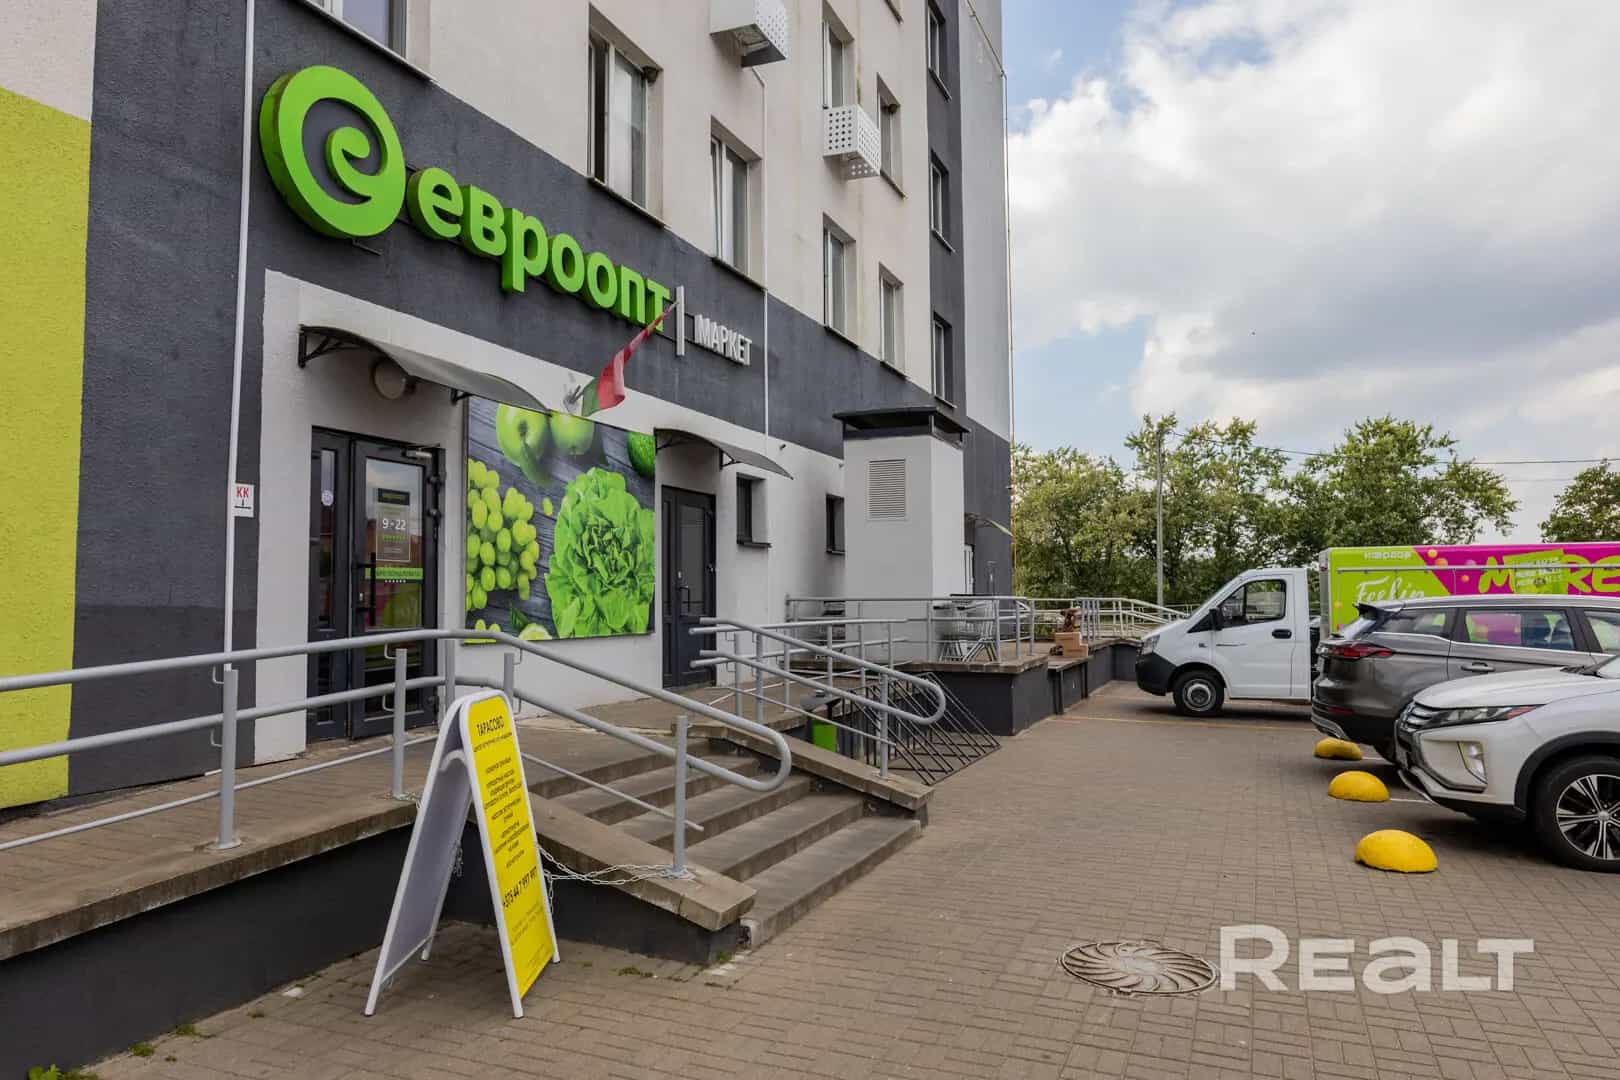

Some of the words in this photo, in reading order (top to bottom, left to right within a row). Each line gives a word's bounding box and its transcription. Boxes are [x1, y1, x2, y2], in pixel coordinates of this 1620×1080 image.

[407, 168, 671, 332] евроопт
[695, 314, 752, 365] МАРКЕТ
[236, 486, 249, 498] КК
